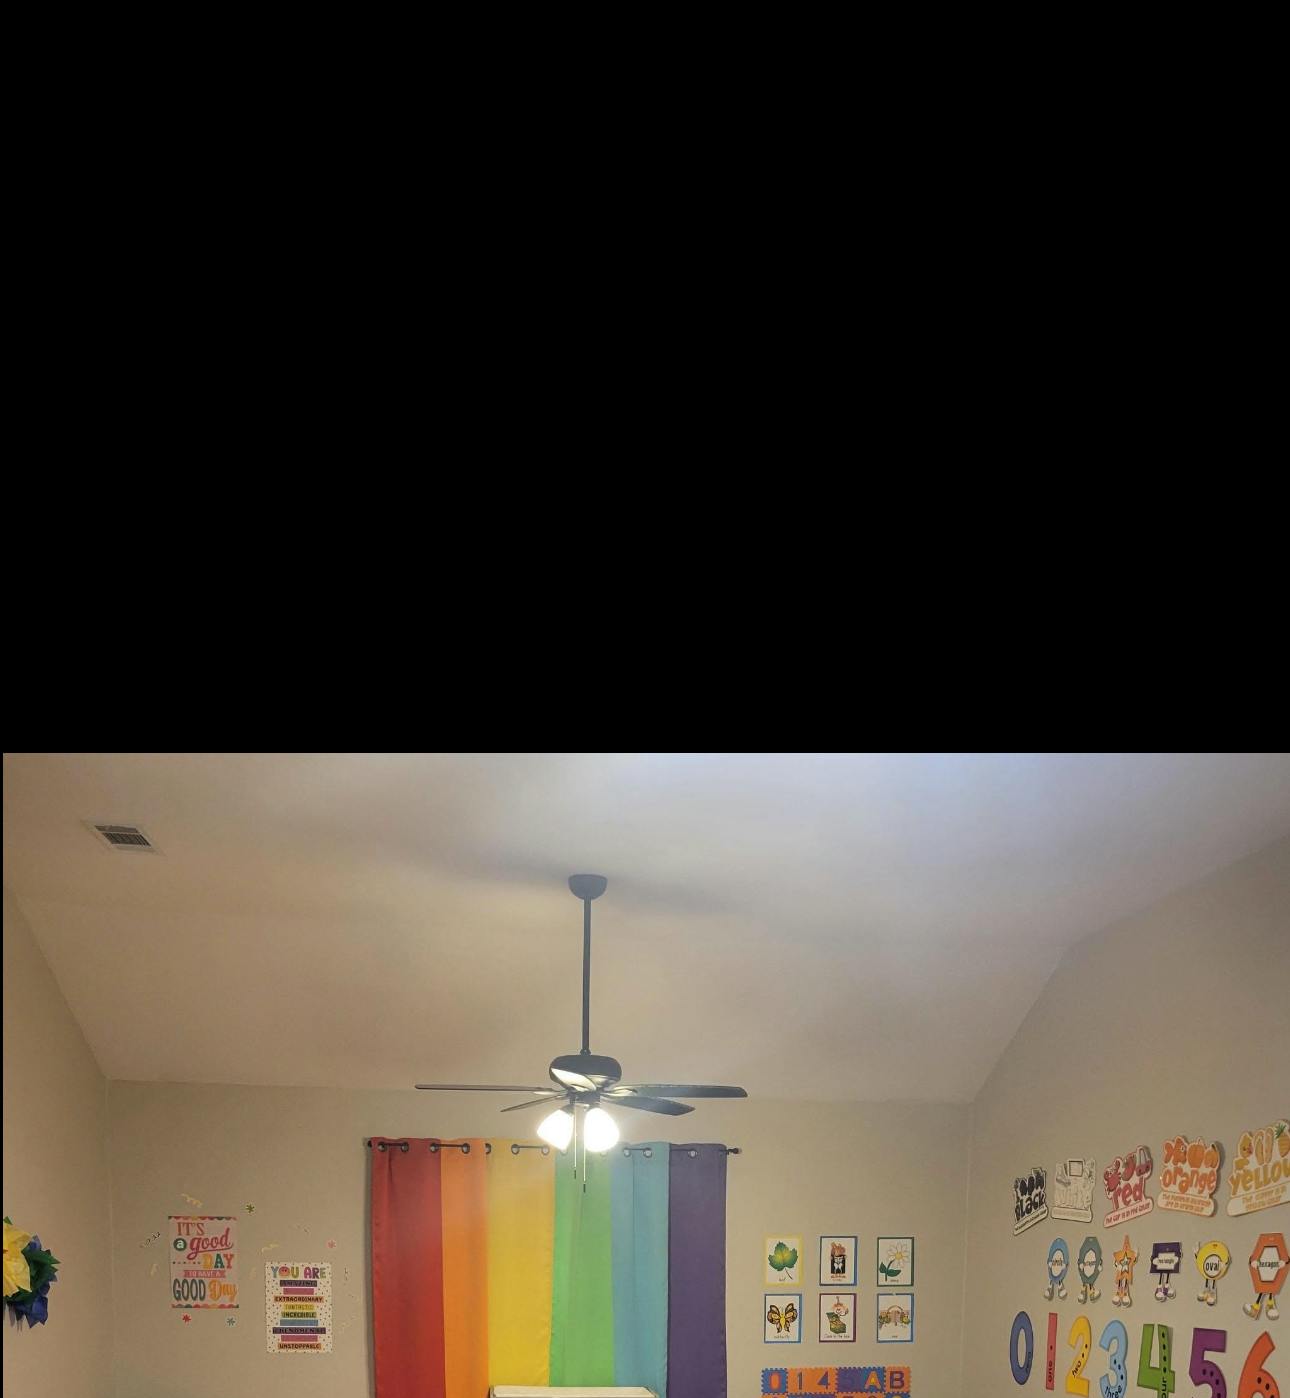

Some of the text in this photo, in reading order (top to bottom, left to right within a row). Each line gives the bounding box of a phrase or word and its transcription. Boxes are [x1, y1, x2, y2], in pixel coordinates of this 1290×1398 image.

[1162, 1167, 1217, 1194] orange
[1113, 1176, 1144, 1211] red
[177, 1222, 205, 1236] IT'S
[176, 1227, 234, 1260] a good
[202, 1253, 234, 1269] DAY
[1205, 1260, 1219, 1271] oval
[271, 1266, 327, 1279] YOU ARE
[172, 1278, 237, 1302] GOOD Day
[1065, 1315, 1092, 1398] 2
[797, 1371, 803, 1390] 1
[817, 1371, 830, 1390] 4
[864, 1370, 881, 1390] A
[889, 1370, 905, 1389] B
